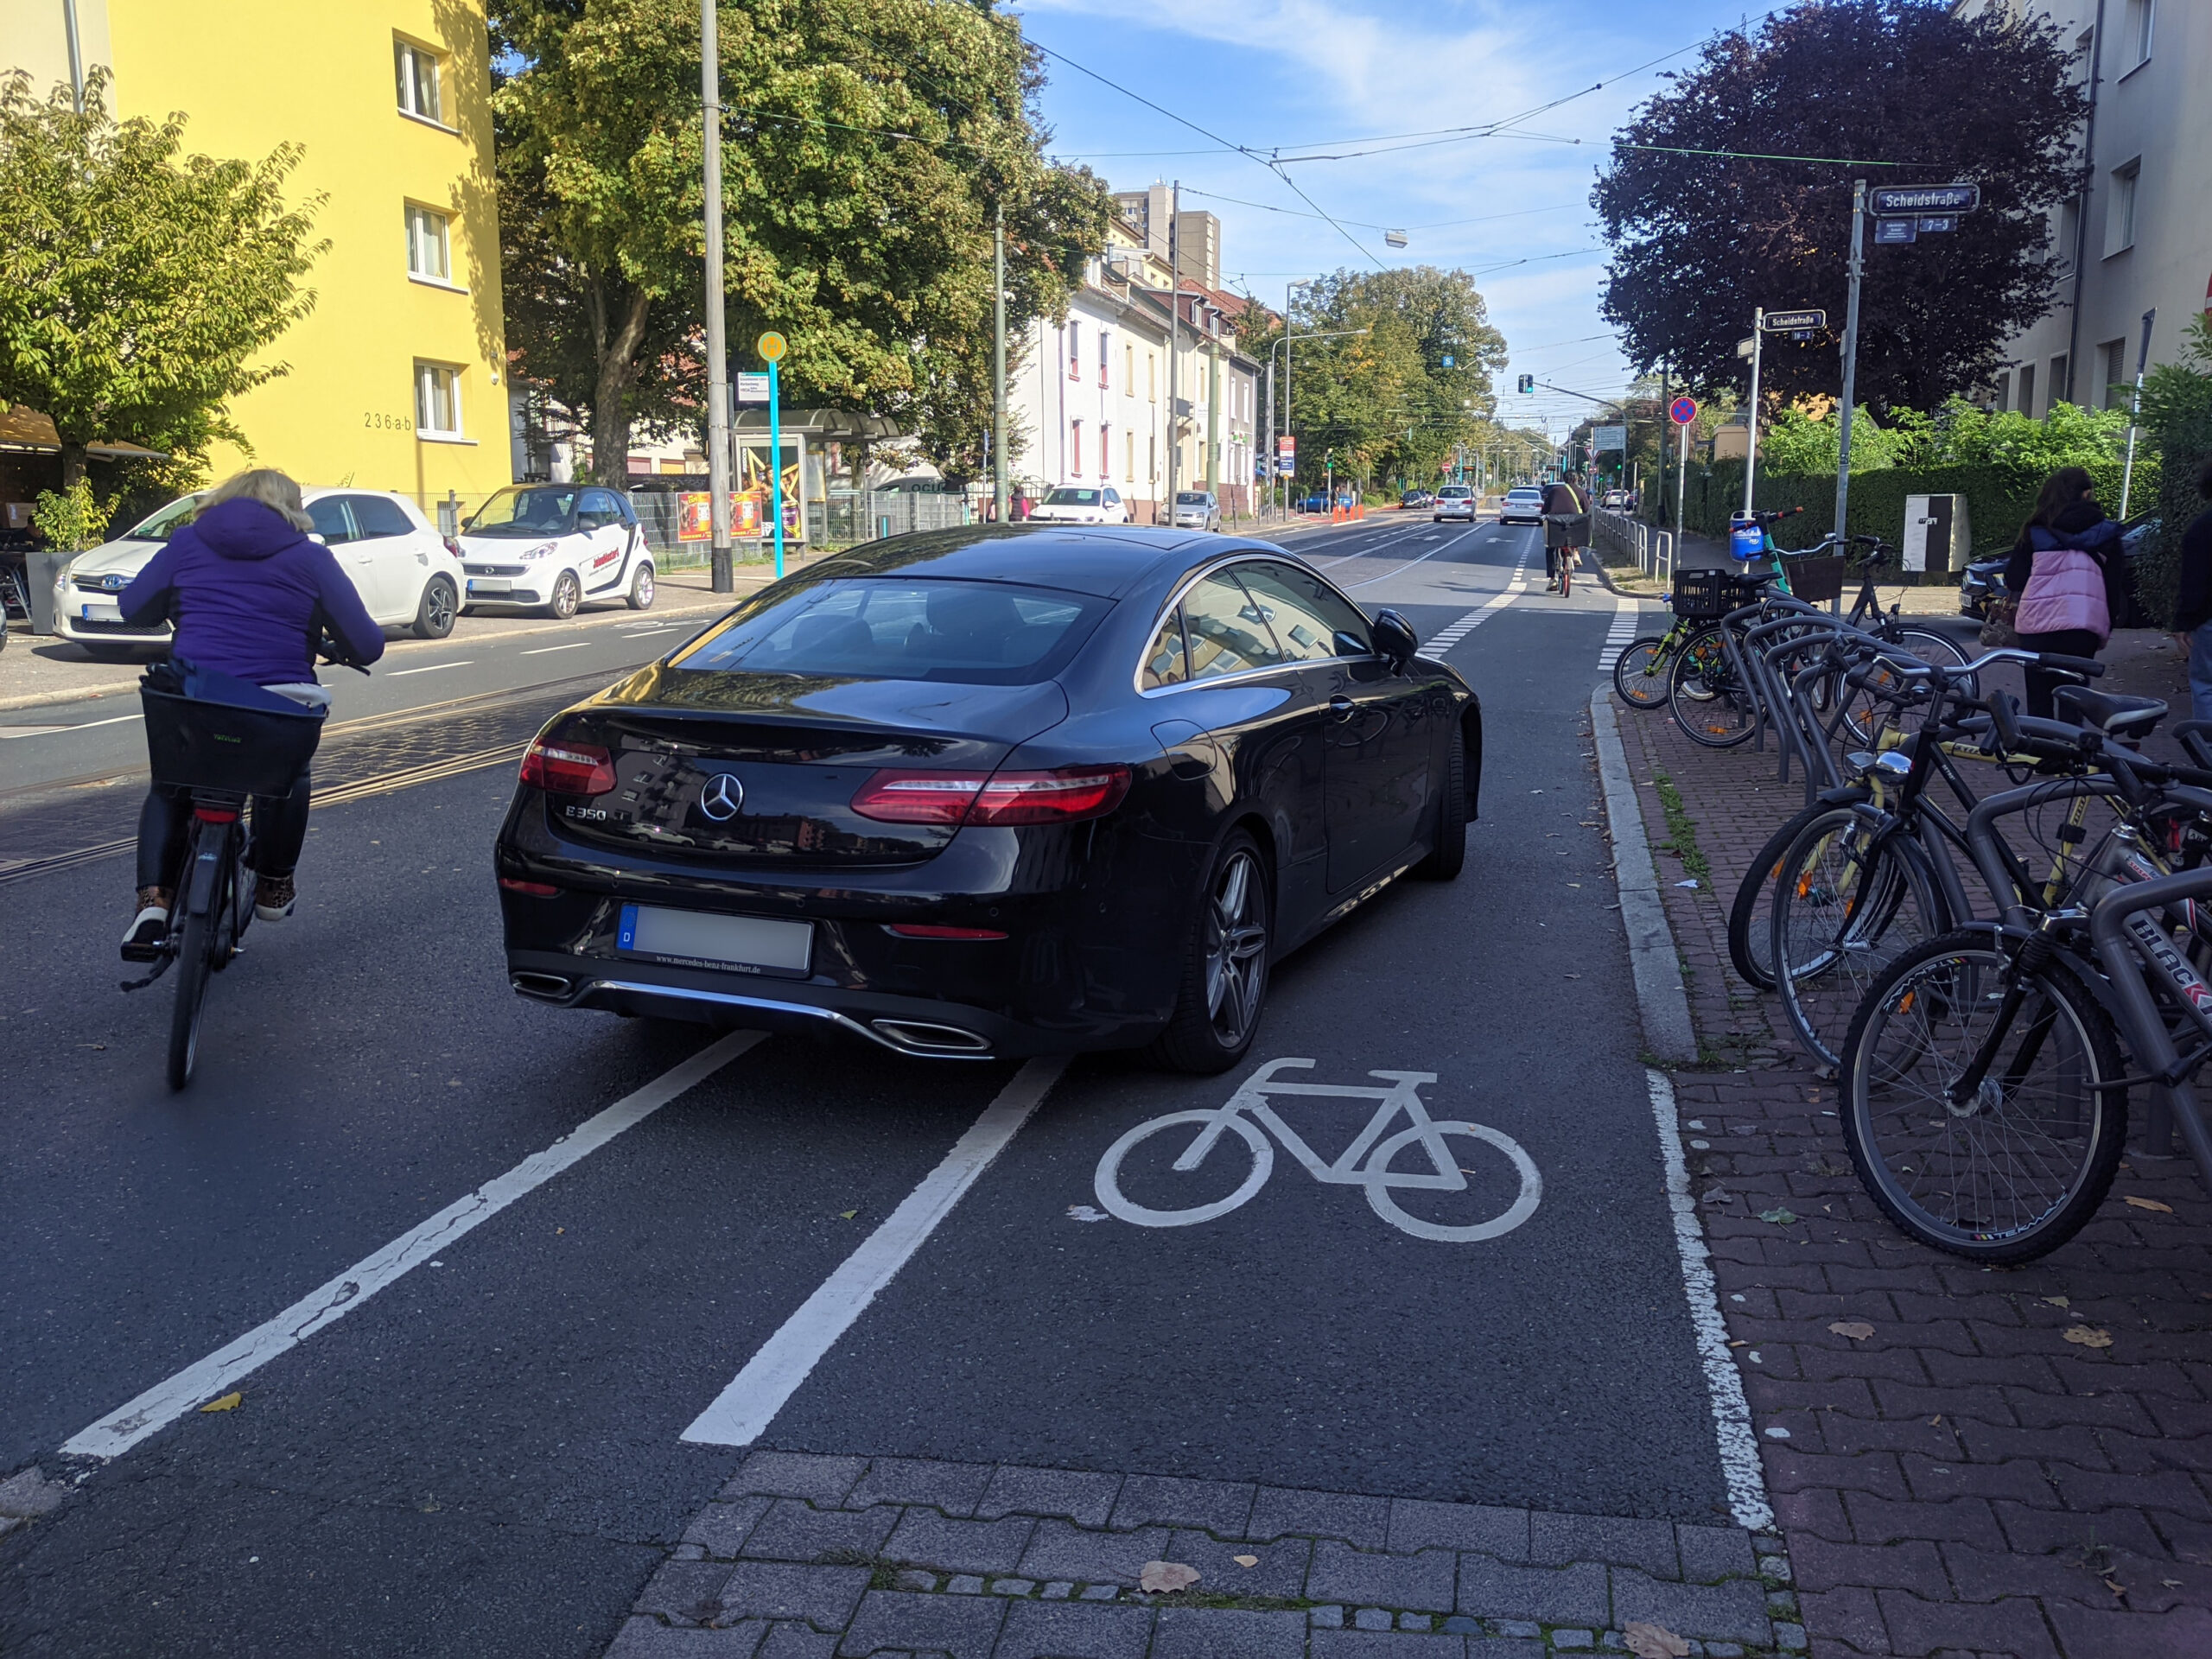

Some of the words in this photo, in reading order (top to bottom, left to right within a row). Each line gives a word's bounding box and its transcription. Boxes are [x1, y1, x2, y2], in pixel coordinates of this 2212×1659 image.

[1885, 192, 1961, 207] Scheidstraße
[1772, 315, 1815, 327] Scheidstraße
[766, 337, 779, 356] H
[623, 931, 631, 943] D
[656, 954, 761, 975] www.mercedes-benz-frankfurt.de
